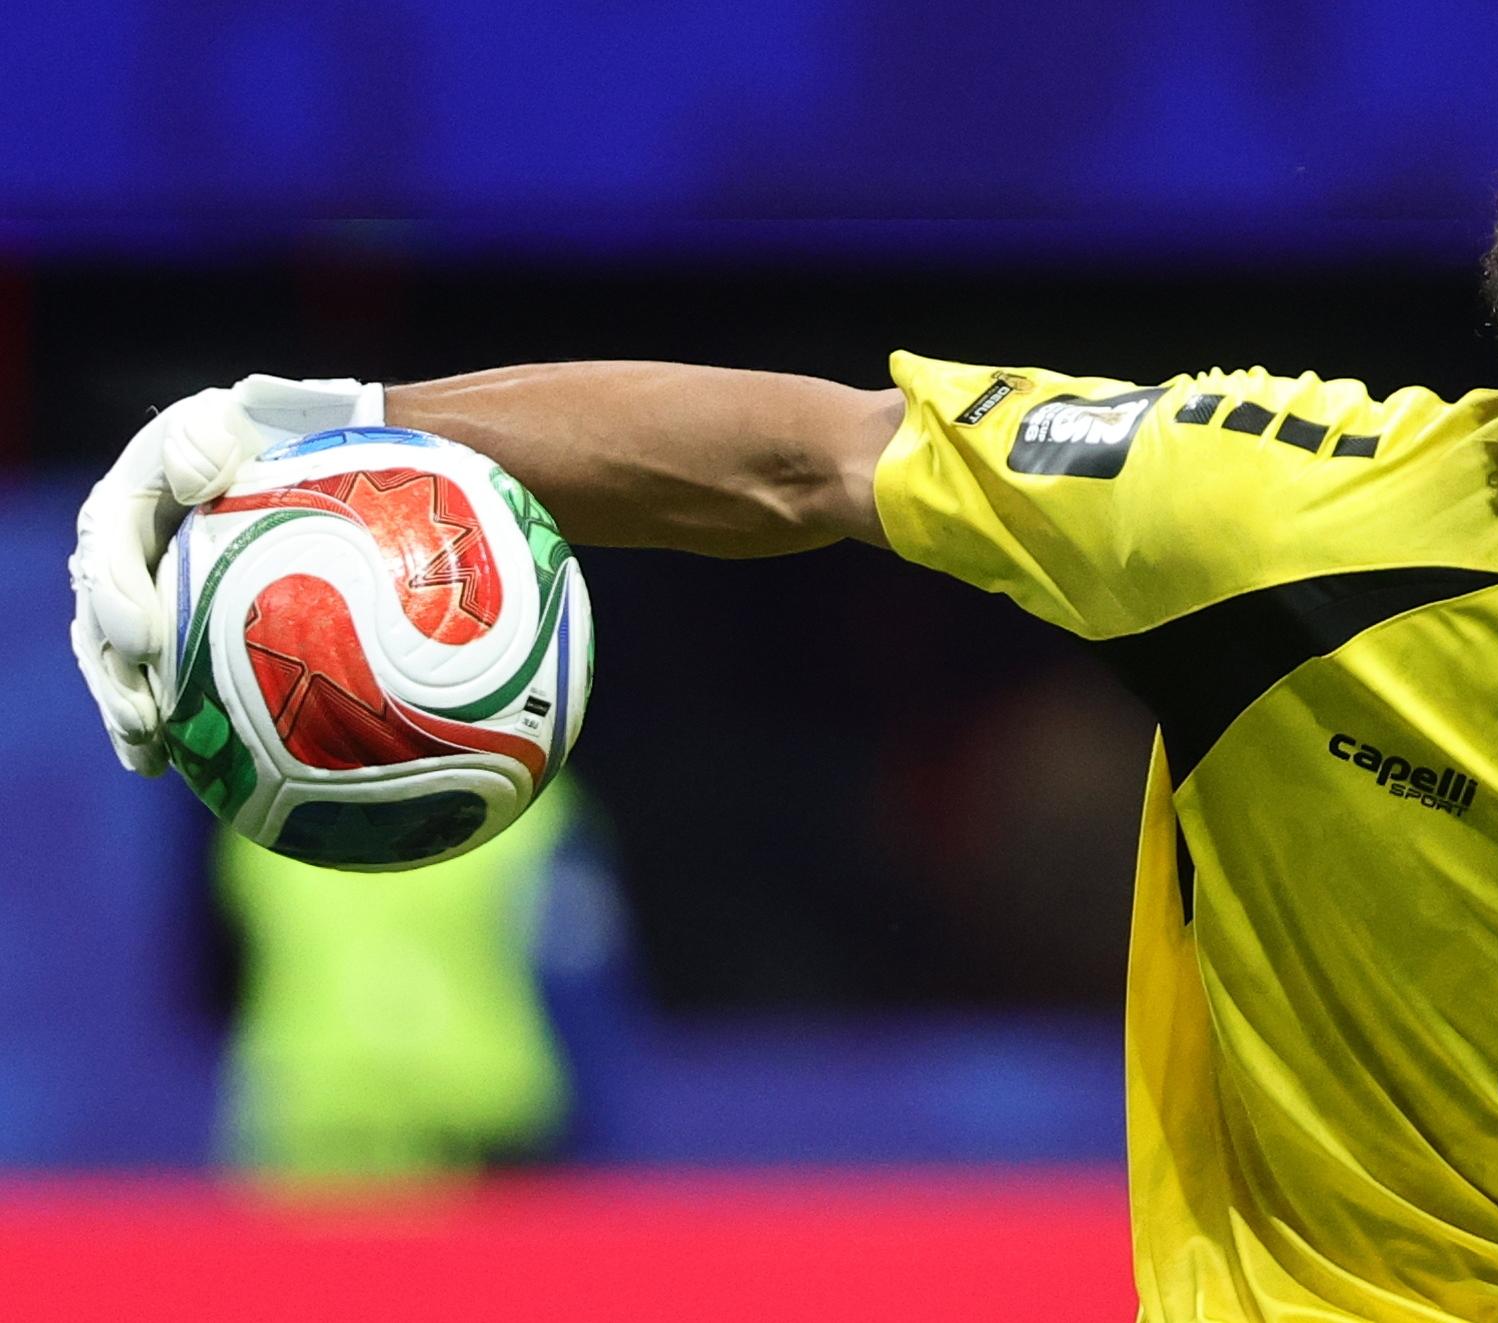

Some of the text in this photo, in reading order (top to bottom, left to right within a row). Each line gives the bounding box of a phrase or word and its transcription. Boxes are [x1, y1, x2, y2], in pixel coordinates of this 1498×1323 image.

[968, 386, 1011, 424] DEBUT
[1329, 733, 1478, 808] capelli
[1389, 783, 1469, 817] SPORT
